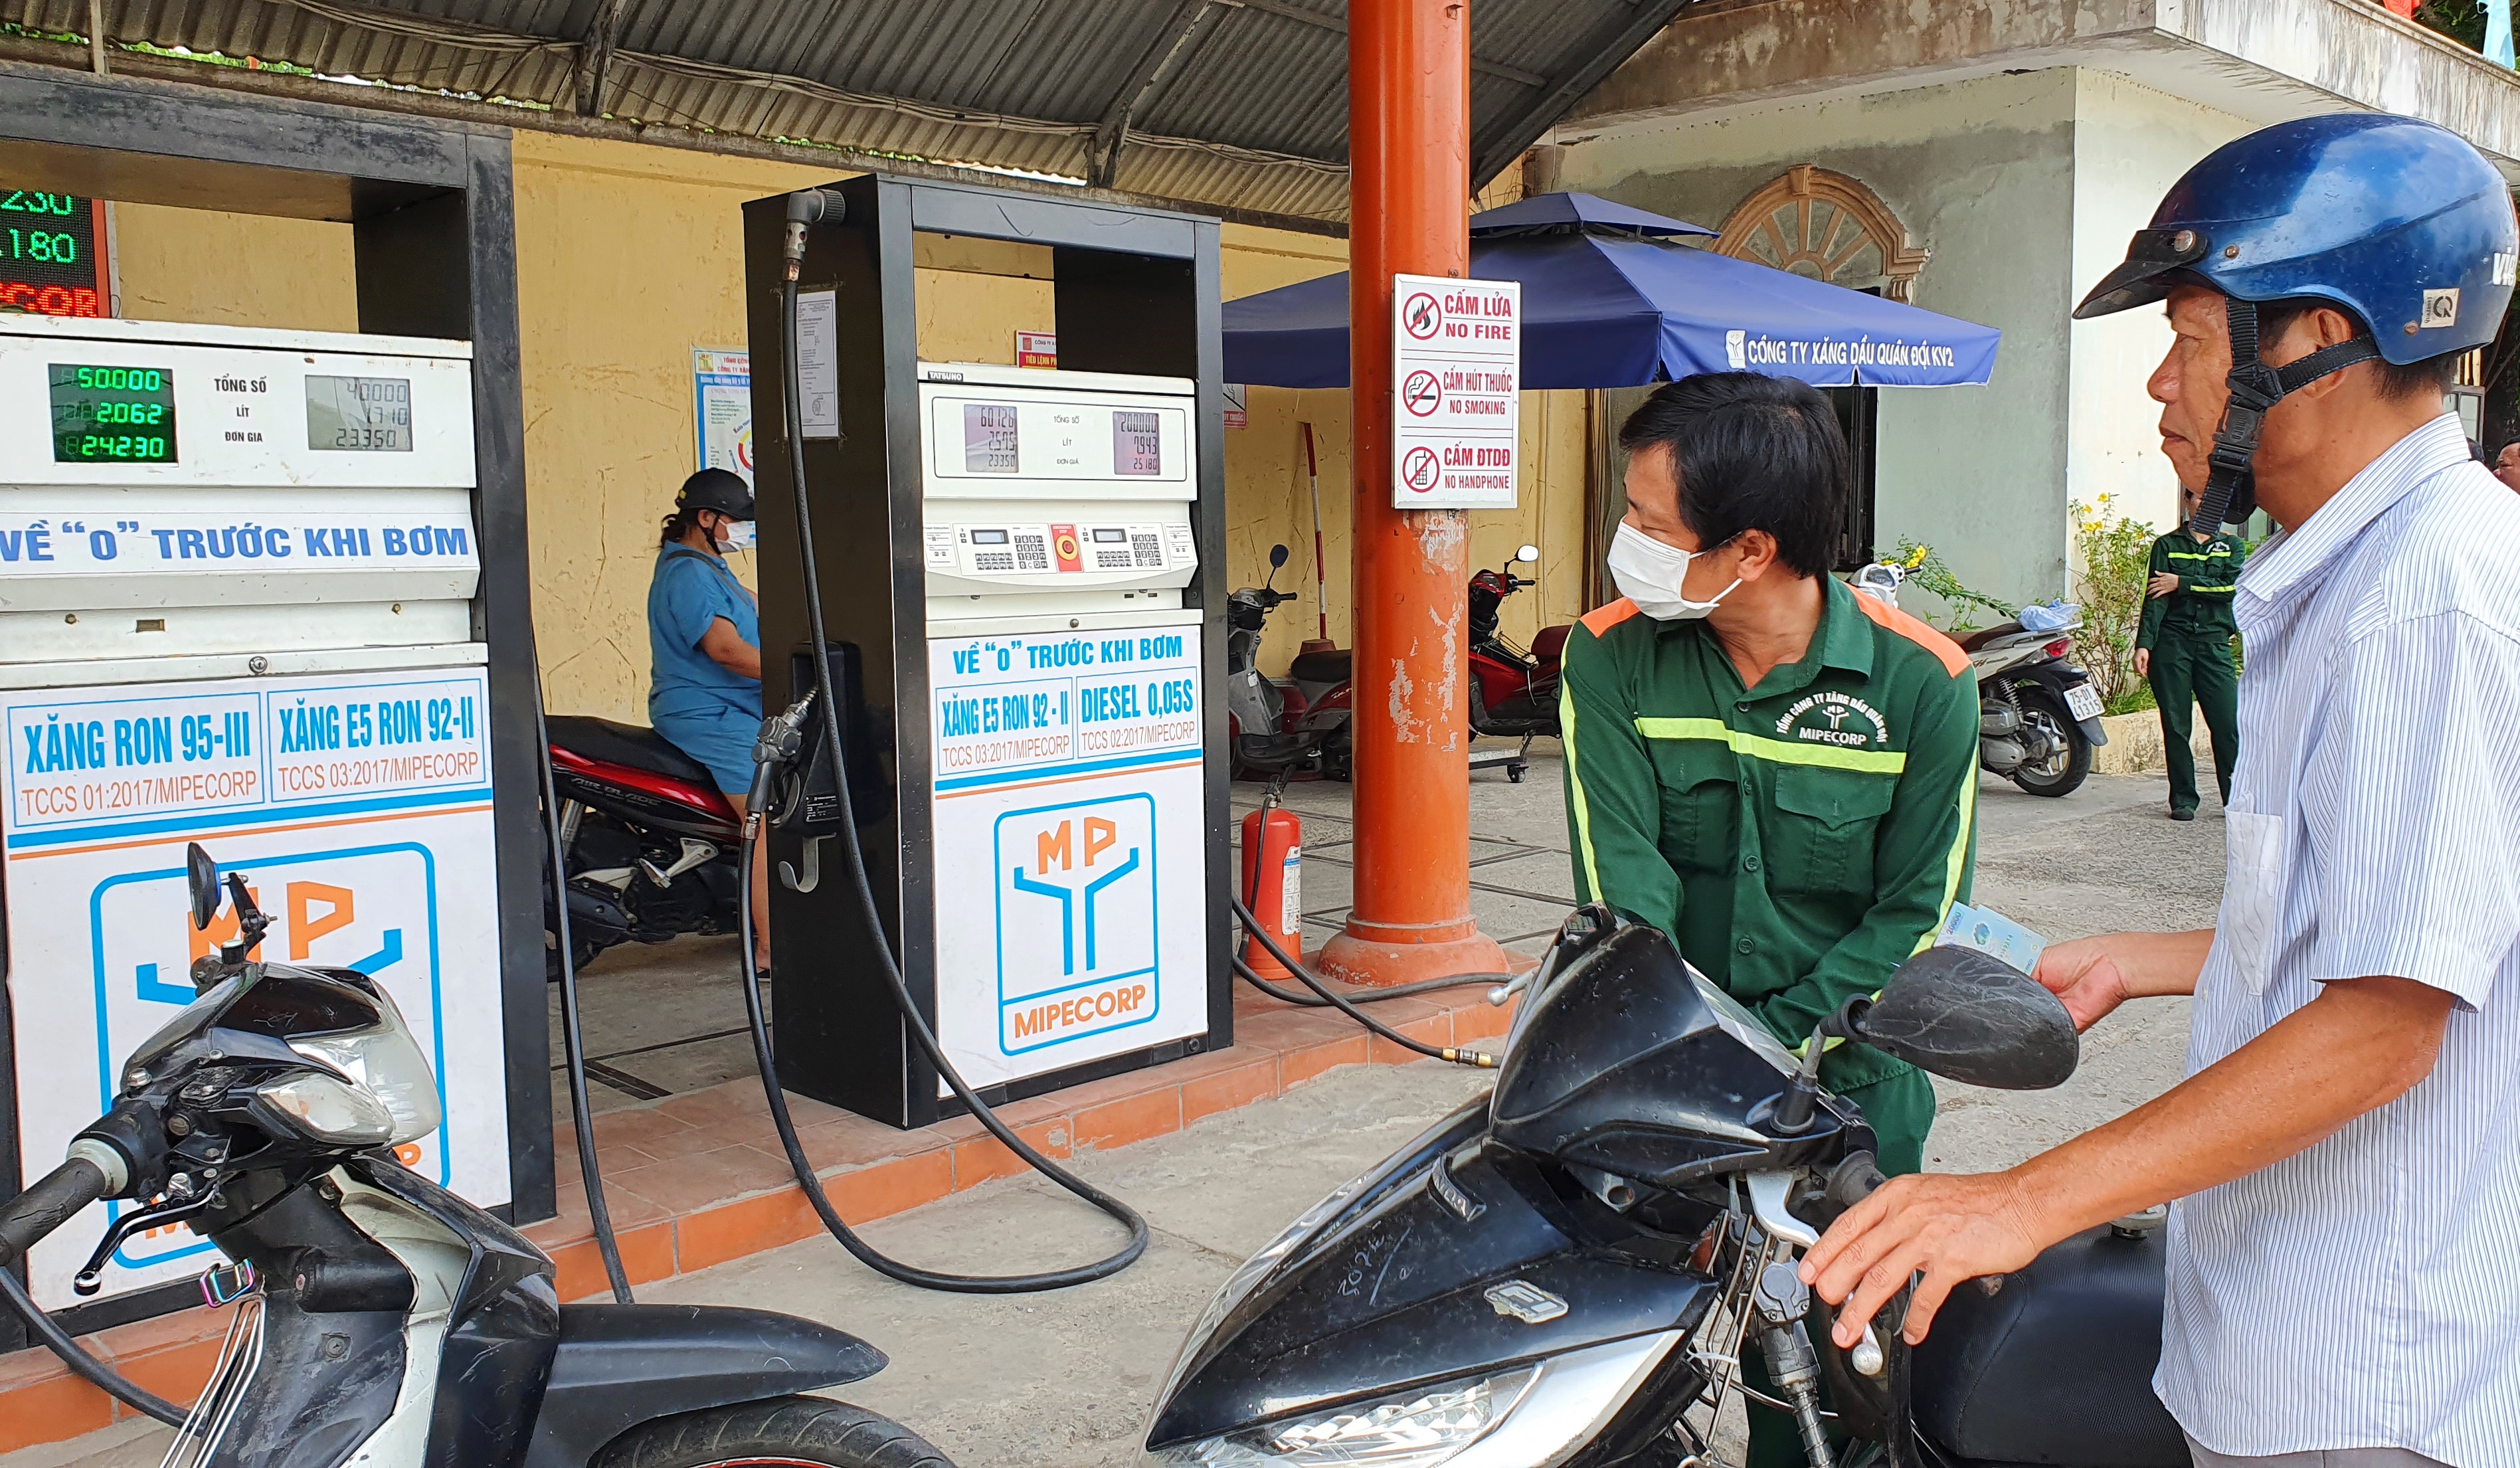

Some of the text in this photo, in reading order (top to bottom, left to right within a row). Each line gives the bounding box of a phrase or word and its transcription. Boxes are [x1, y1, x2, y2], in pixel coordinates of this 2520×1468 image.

[1445, 288, 1512, 318] CẤM LỬA
[1445, 323, 1511, 340] NO FIRE
[1748, 334, 1787, 364] CÔNG
[1789, 341, 1809, 365] TY
[1811, 335, 1847, 365] XĂNG
[1876, 338, 1910, 366] QUÂN
[1910, 339, 1931, 371] ĐỘI
[1931, 345, 1955, 367] KV2
[214, 373, 267, 393] TỔNG SỐ
[929, 372, 962, 381] TATSUNO
[1443, 365, 1512, 393] CẤM HÚT THUỐC
[236, 404, 250, 418] LÍT
[980, 407, 1014, 428] 60126
[1449, 399, 1505, 415] NO SMOKING
[225, 430, 264, 442] ĐƠN GIA
[1062, 437, 1072, 446] LÍT
[1444, 441, 1510, 467] CẤM ĐTDĐ
[1445, 474, 1509, 490] NO HANDPHONE
[0, 518, 54, 562] VỀ
[151, 522, 292, 560] TRƯỚC
[306, 528, 371, 557] KHI
[384, 525, 469, 557] BƠM
[952, 641, 980, 674] VỀ
[1027, 638, 1095, 669] TRƯỚC
[1101, 639, 1133, 663] KHI
[1140, 634, 1182, 660] BƠM
[943, 691, 980, 737] XĂNG
[984, 696, 999, 733] E5
[1002, 694, 1030, 731] RON
[1034, 693, 1048, 728] 92
[1081, 678, 1194, 723] DIESEL 0,05S
[1827, 705, 1845, 714] MP
[279, 695, 475, 753] XĂNG E5 RON 92-II
[1081, 720, 1195, 751] TCCS 02:2017/MIPECORP
[1799, 727, 1867, 746] MIPECORP
[24, 711, 251, 774] XĂNG RON 95-III
[943, 734, 1070, 768] TCCS 03:2017/MIPECORP
[278, 751, 479, 793] TCCS 03:2017/MIPECORP
[22, 771, 257, 816] TCCS 01:2017/MIPECORP
[1037, 816, 1116, 875] MP
[1014, 984, 1146, 1038] MIPECORP
